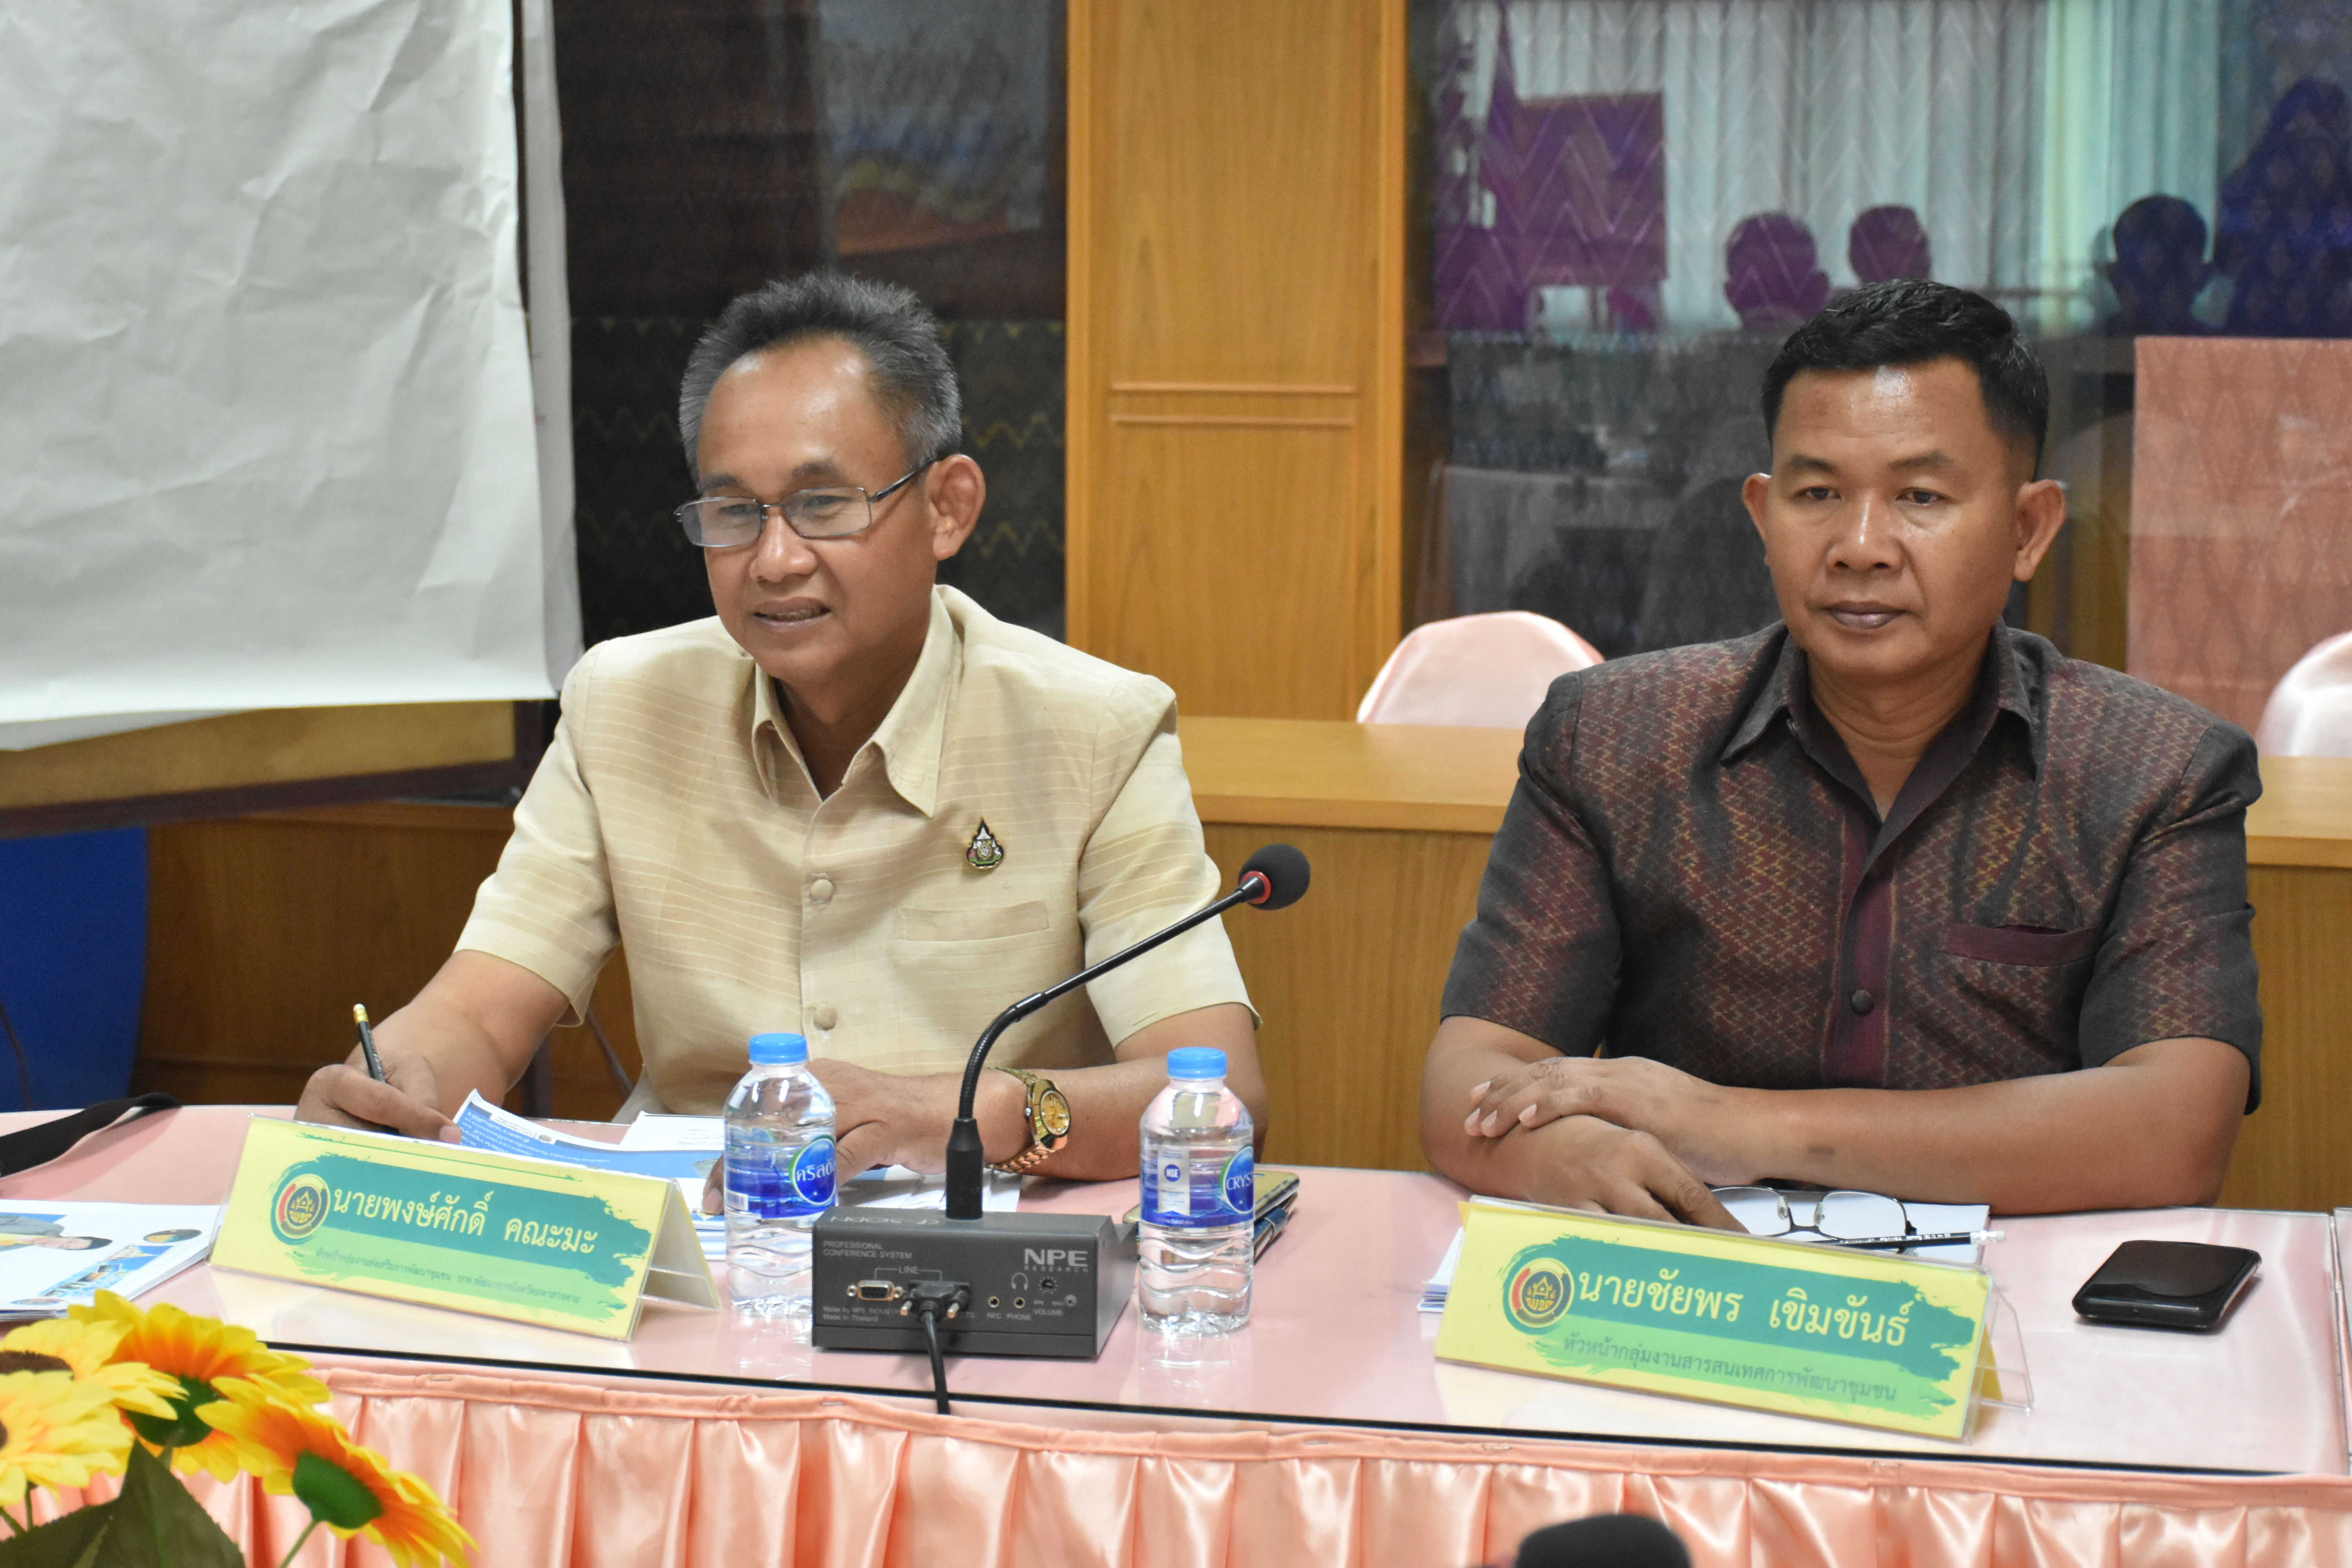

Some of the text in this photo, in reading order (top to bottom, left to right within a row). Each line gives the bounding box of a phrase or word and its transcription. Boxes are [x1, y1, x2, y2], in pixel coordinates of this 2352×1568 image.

[334, 1189, 598, 1254] นายพงษ์ศักดิ์ คณะมะ
[823, 1241, 882, 1250] PROFESSIONAL
[824, 1249, 877, 1258] CONFERENCE
[1024, 1248, 1088, 1267] NPE
[1579, 1269, 1915, 1346] นายชัยพร เขิมขันธ์
[1564, 1332, 1896, 1402] หัวหน้ากลุ่มงานสารสนเทศการพัฒนาชุมชน
